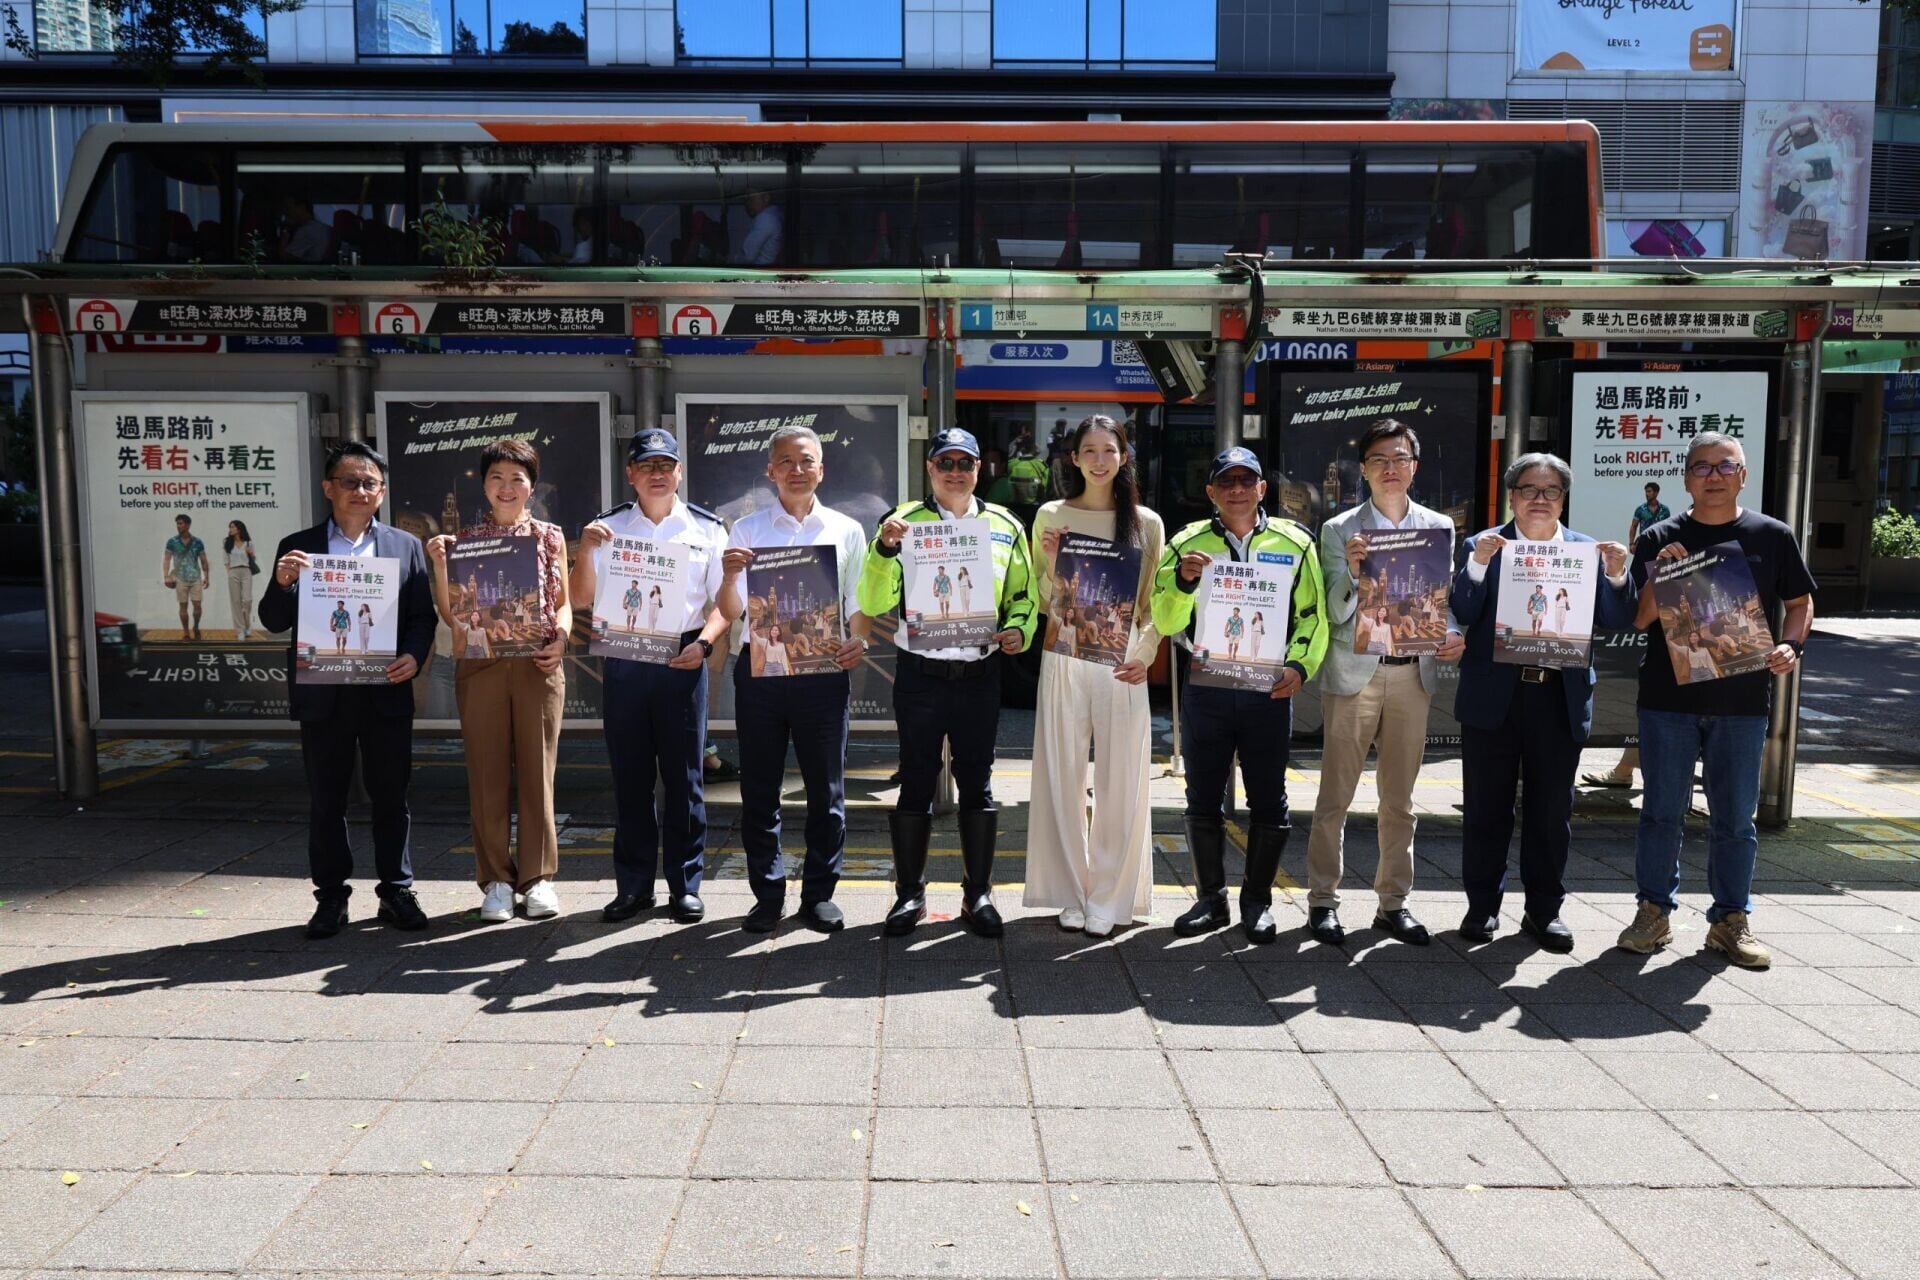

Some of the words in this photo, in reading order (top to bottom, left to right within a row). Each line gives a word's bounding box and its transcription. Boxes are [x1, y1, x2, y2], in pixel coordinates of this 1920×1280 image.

[1606, 39, 1632, 47] LEVEL
[1634, 39, 1640, 47] 2
[94, 314, 104, 331] 6
[972, 310, 980, 326] 1
[1092, 310, 1114, 327] 1A
[1121, 310, 1164, 321] 中秀茂坪
[1292, 311, 1462, 326] 乘坐九巴6號線穿梭彌敦道
[1582, 312, 1750, 327] 乘坐九巴6號線穿梭彌敦道
[392, 318, 404, 334] 6
[689, 319, 700, 335] 6
[1005, 346, 1054, 358] 服務人次
[1366, 363, 1394, 372] Asiaray
[1653, 362, 1680, 371] Asiaray
[1305, 382, 1402, 405] 切勿在馬路上拍照
[1595, 386, 1701, 410] 過馬路前，
[1290, 412, 1321, 425] Never
[1322, 408, 1343, 421] take
[1344, 404, 1380, 421] photos
[1381, 403, 1395, 413] on
[1397, 398, 1422, 412] road
[116, 415, 227, 440] 過馬路前，
[418, 412, 518, 435] 切勿在馬路上拍照
[405, 441, 435, 455] Never
[437, 437, 459, 451] take
[460, 434, 498, 452] photos
[705, 441, 736, 455] Never
[737, 438, 759, 451] take
[118, 445, 276, 471] 先看右、再看左
[1594, 453, 1622, 464] Look
[1626, 451, 1672, 465] RIGHT,
[1594, 468, 1624, 477] before
[1626, 469, 1643, 478] you
[1645, 468, 1664, 478] step
[1666, 467, 1678, 476] off
[120, 484, 148, 496] Look
[152, 482, 202, 497] RIGHT,
[205, 484, 231, 495] then
[236, 482, 275, 497] LEFT,
[120, 499, 151, 509] before
[154, 501, 171, 511] you
[174, 500, 194, 510] step
[196, 499, 209, 509] off
[211, 499, 227, 509] the
[229, 500, 279, 510] pavement.
[1606, 633, 1648, 647] GHT
[149, 668, 220, 682] RIGHT
[240, 668, 288, 682] OOK
